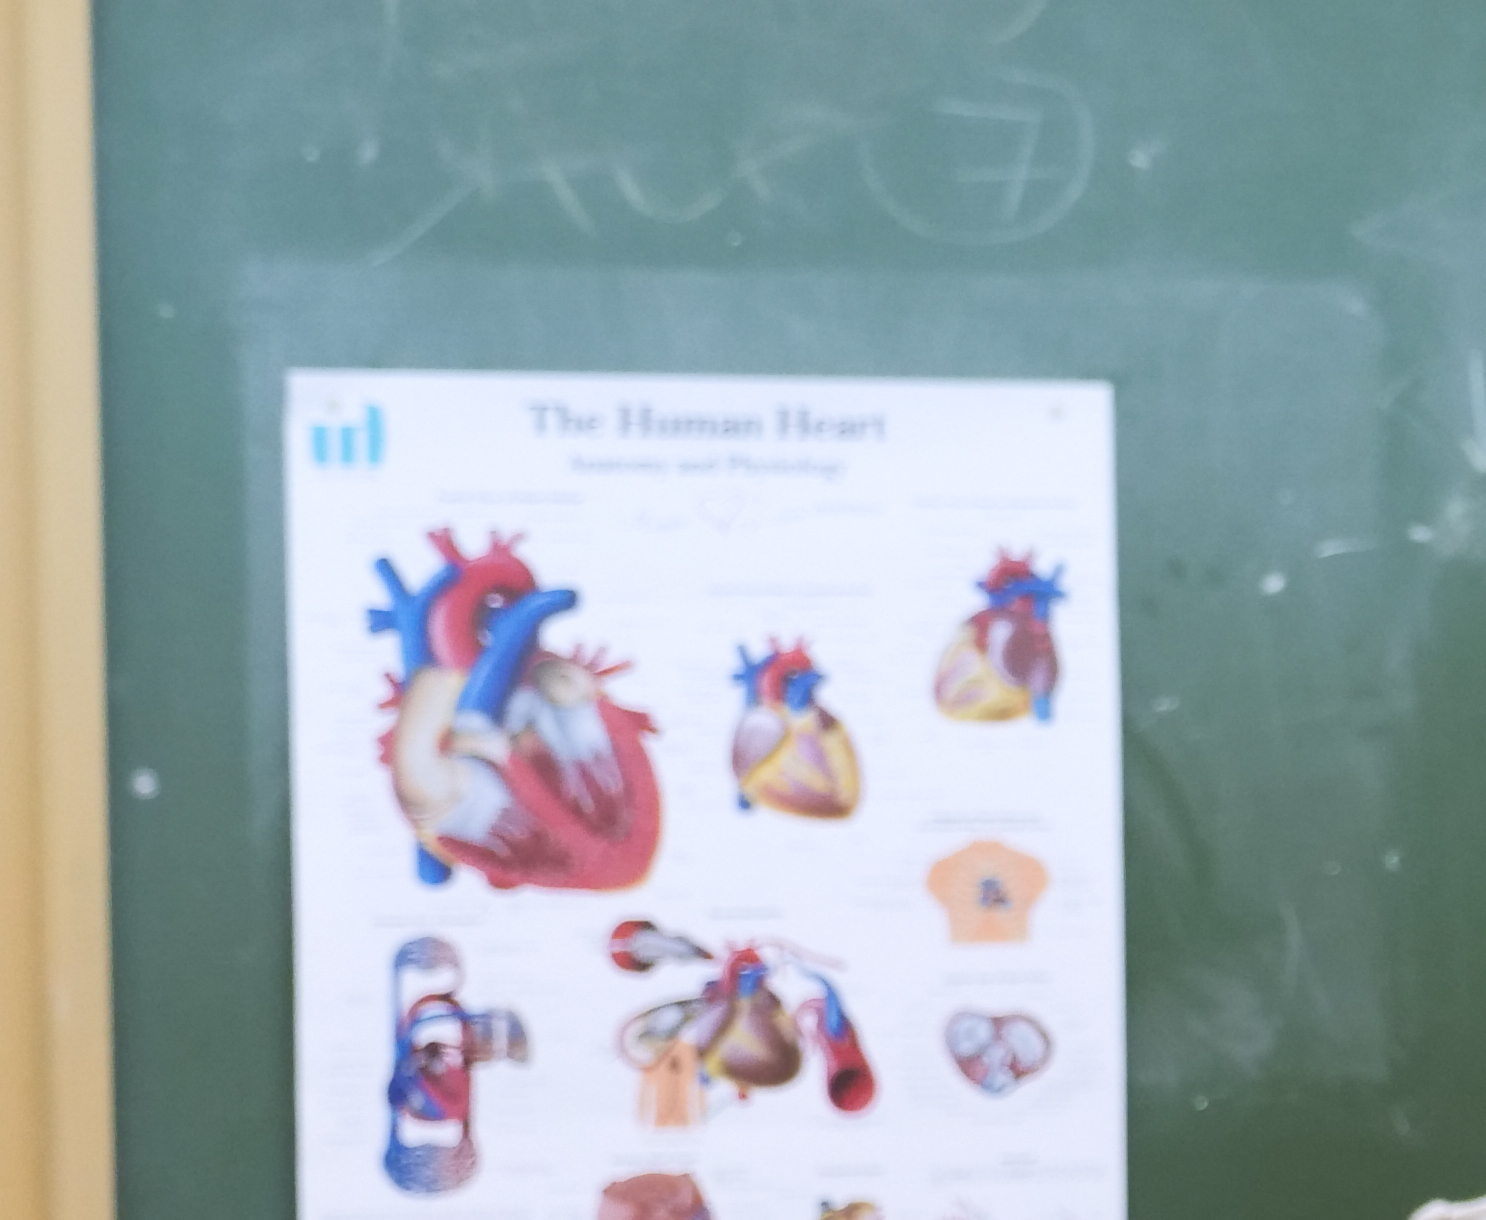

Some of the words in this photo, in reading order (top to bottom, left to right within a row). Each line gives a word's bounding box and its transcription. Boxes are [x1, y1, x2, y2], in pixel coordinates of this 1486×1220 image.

[529, 403, 602, 439] The
[618, 405, 762, 440] Human
[776, 407, 886, 441] Heart
